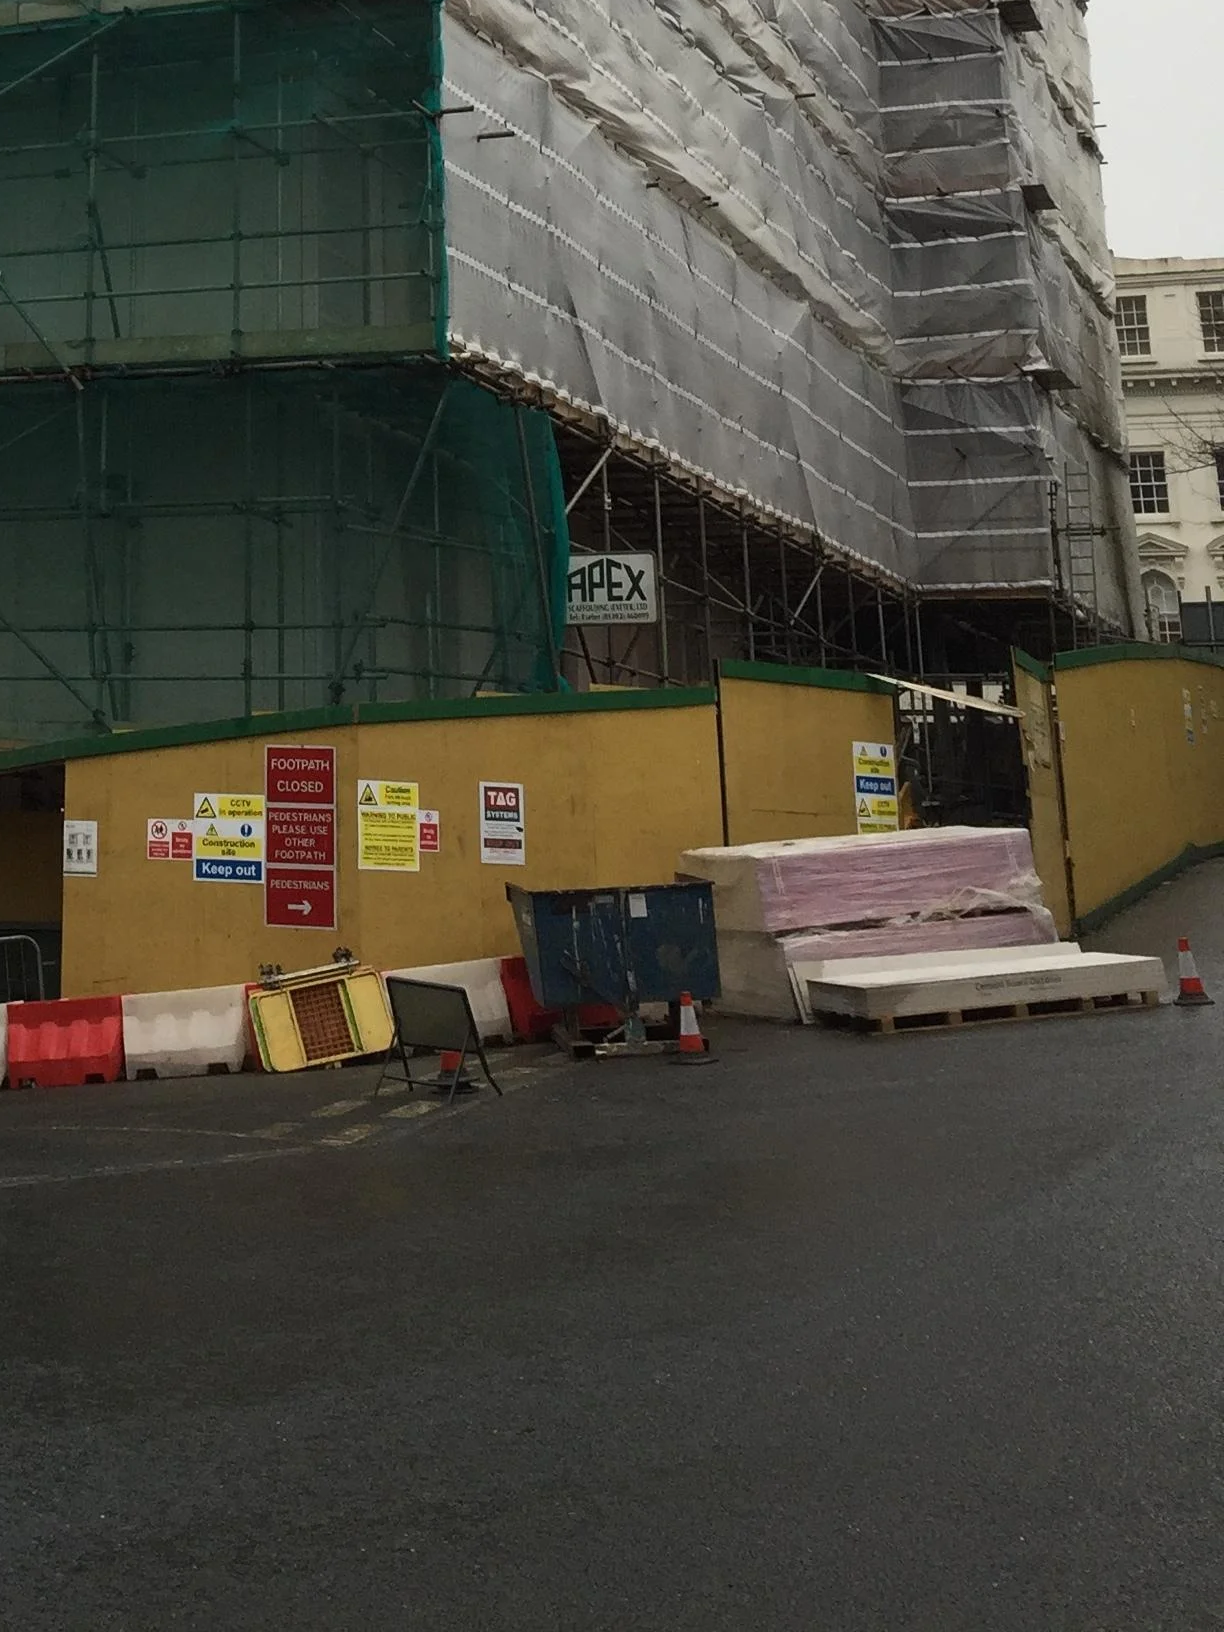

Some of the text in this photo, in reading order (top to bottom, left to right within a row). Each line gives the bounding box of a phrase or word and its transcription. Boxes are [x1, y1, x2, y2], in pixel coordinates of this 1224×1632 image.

[567, 557, 647, 603] APEX
[271, 758, 331, 771] FOOTPATH
[277, 780, 324, 793] CLOSED
[859, 778, 892, 792] Keep out
[230, 798, 251, 808] CCTV
[487, 791, 517, 807] TAG
[268, 811, 332, 823] PEDESTRIANS
[486, 810, 519, 819] SYSTEMS
[272, 824, 329, 836] PLEASE USE
[202, 838, 256, 849] Construction
[284, 837, 316, 848] OTHER
[274, 849, 326, 861] FOOTPATH
[201, 862, 257, 878] Keep out
[270, 879, 330, 891] PEDESTRIANS
